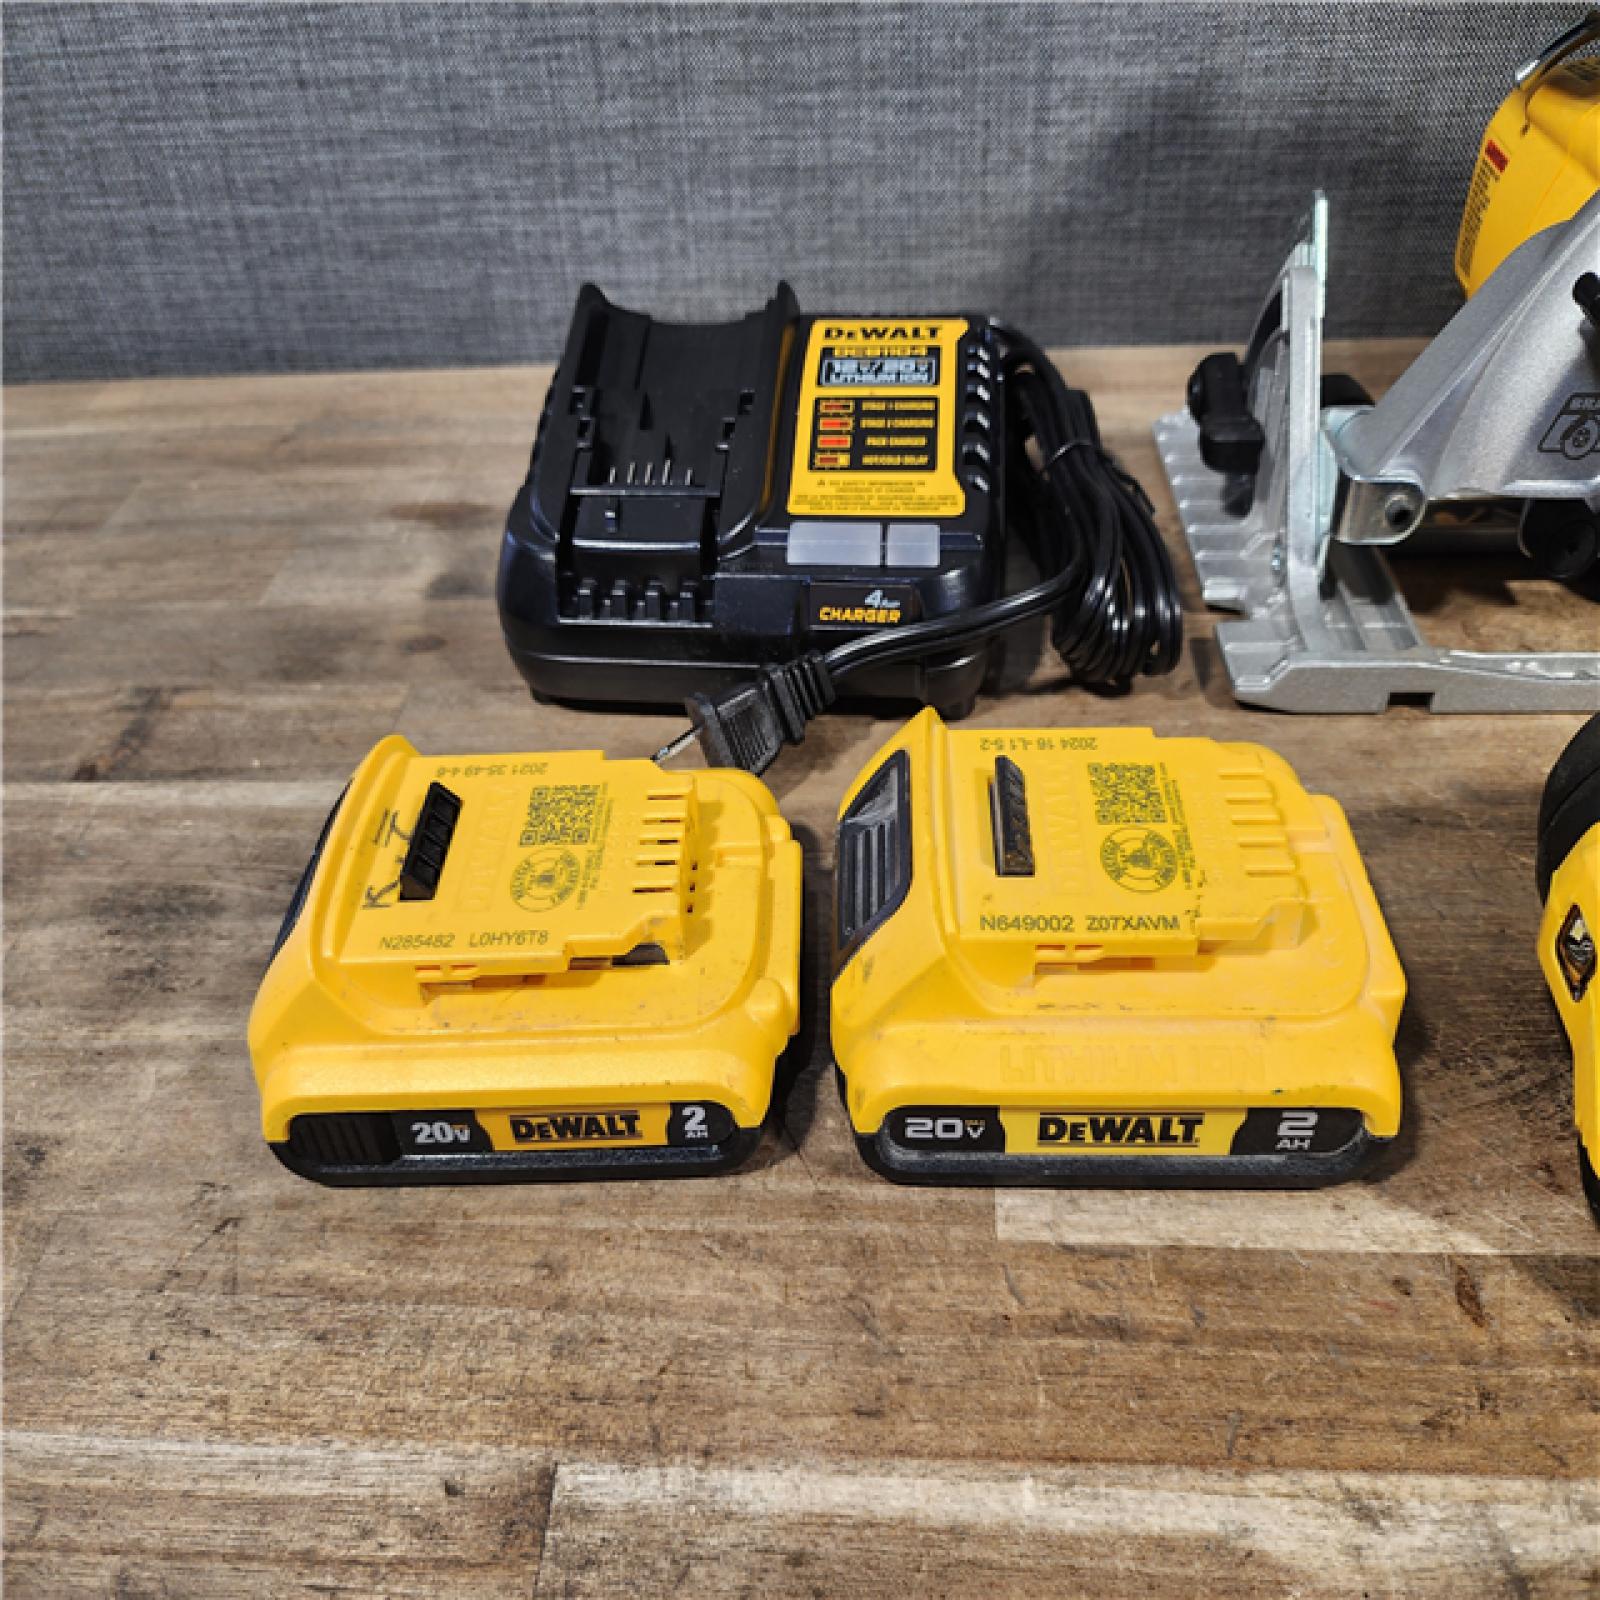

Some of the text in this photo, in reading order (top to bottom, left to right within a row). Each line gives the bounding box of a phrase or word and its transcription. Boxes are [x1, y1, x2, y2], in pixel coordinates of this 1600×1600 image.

[819, 606, 901, 623] CHARGER
[979, 914, 1075, 932] N649002
[682, 1106, 706, 1131] 2
[1277, 1111, 1318, 1136] 2
